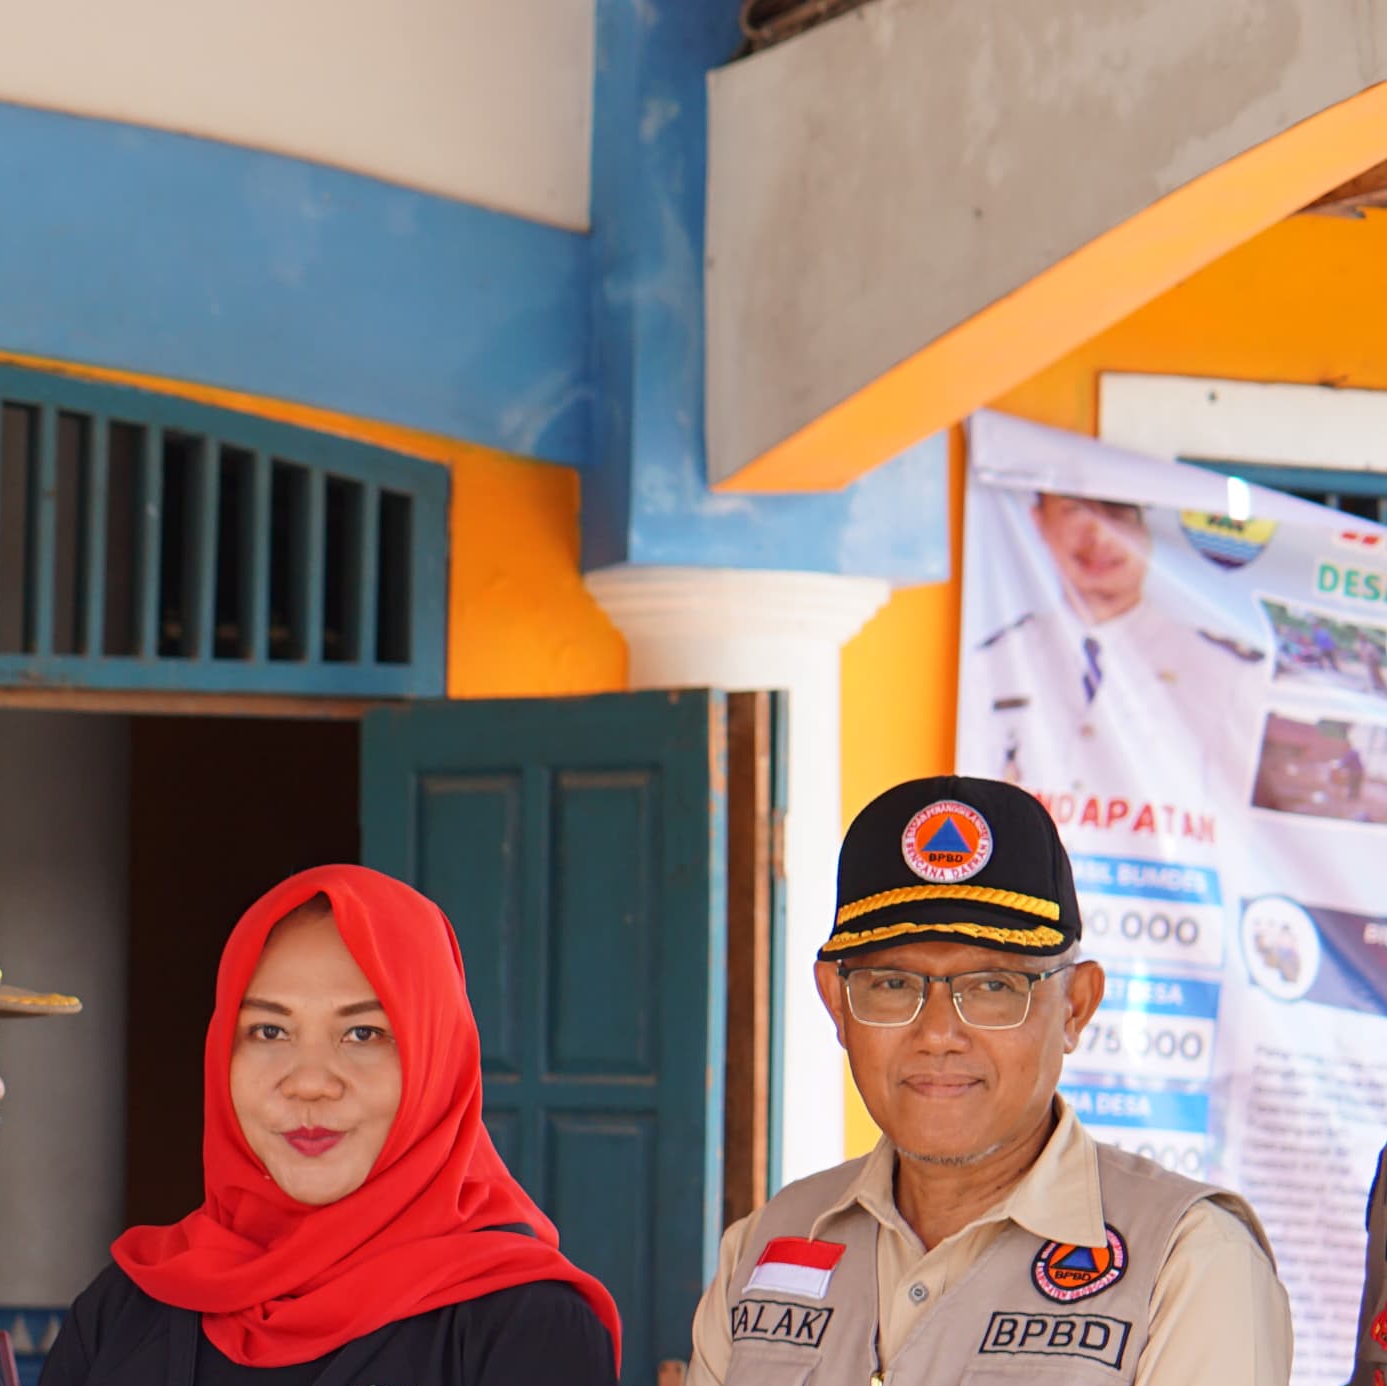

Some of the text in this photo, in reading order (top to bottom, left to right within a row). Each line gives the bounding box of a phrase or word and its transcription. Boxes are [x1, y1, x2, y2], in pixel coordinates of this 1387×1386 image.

[1318, 563, 1387, 602] DES
[928, 853, 963, 863] BPBD
[1054, 1270, 1092, 1281] BPBD
[991, 1317, 1111, 1351] BPBD
